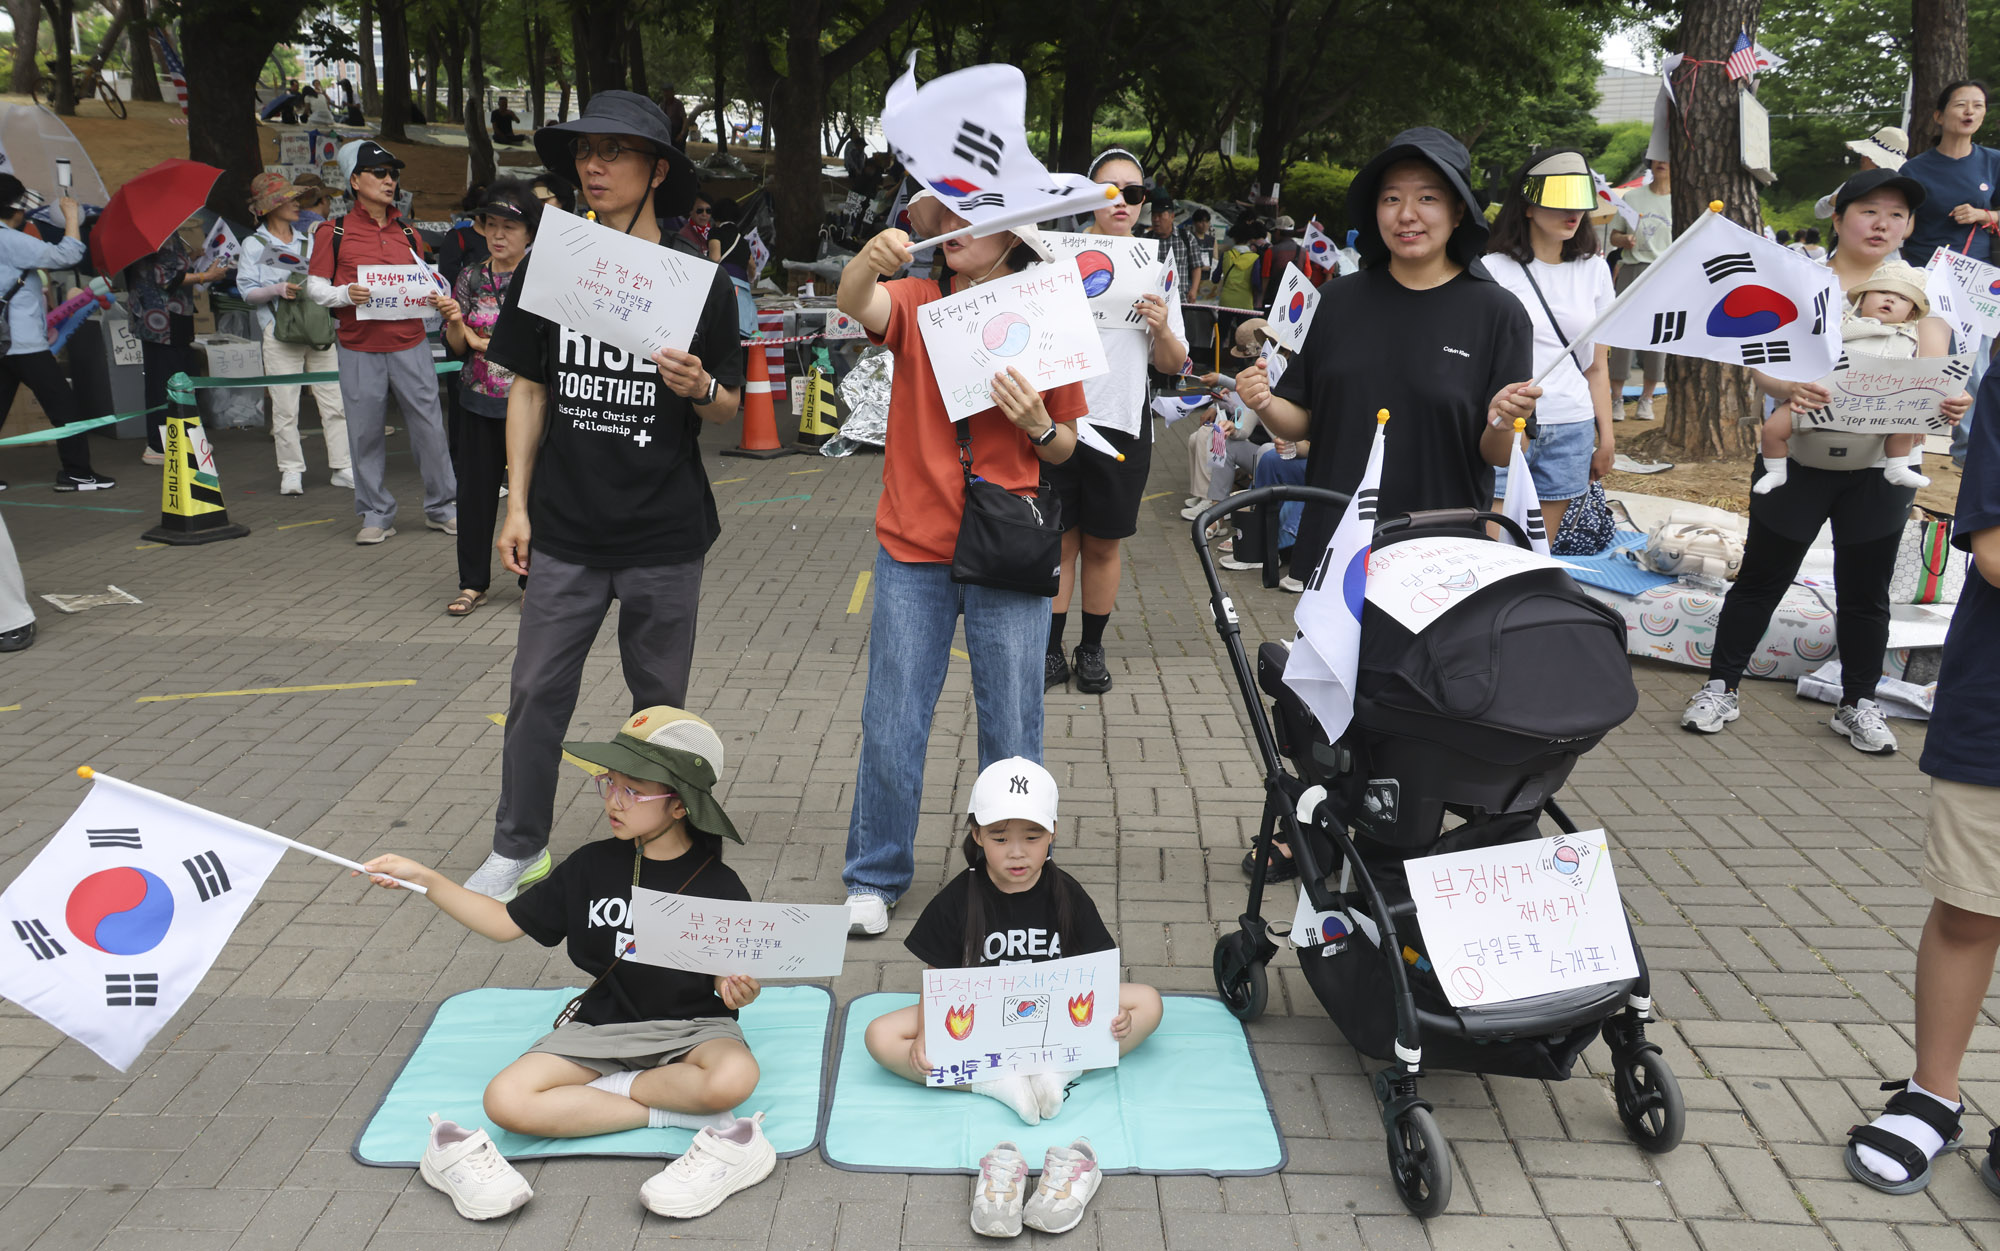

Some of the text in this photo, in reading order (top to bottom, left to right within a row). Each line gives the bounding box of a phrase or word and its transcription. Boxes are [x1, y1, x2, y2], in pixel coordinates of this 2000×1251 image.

[407, 272, 428, 285] 재선
[588, 257, 653, 291] 부정선거
[1011, 272, 1074, 298] 재선거
[576, 276, 653, 313] 재선거 당일투표
[592, 298, 633, 322] 수개표
[928, 291, 997, 328] 부정선거
[1443, 346, 1470, 358] Calvin Klein
[1037, 352, 1092, 380] 수개표
[558, 371, 657, 407] TOGETHER
[1842, 369, 1905, 391] 부정선거
[806, 381, 815, 430] 주차금지
[1894, 397, 1934, 411] 수개표
[573, 420, 631, 437] Fellowship
[602, 411, 637, 423] Christ
[643, 415, 656, 424] of
[1840, 415, 1920, 426] STOP THE STEAL
[168, 440, 178, 510] 주차금지
[1009, 774, 1029, 795] NY
[1432, 863, 1533, 910] 부정선거
[1516, 893, 1589, 923] 재선거!
[688, 912, 776, 934] 부정선거
[680, 931, 783, 949] 재선거 당일투표
[697, 945, 764, 960] 수개표
[980, 927, 1063, 964] OREA
[1464, 934, 1543, 967] 당일투표
[1550, 945, 1619, 979] 수개표!
